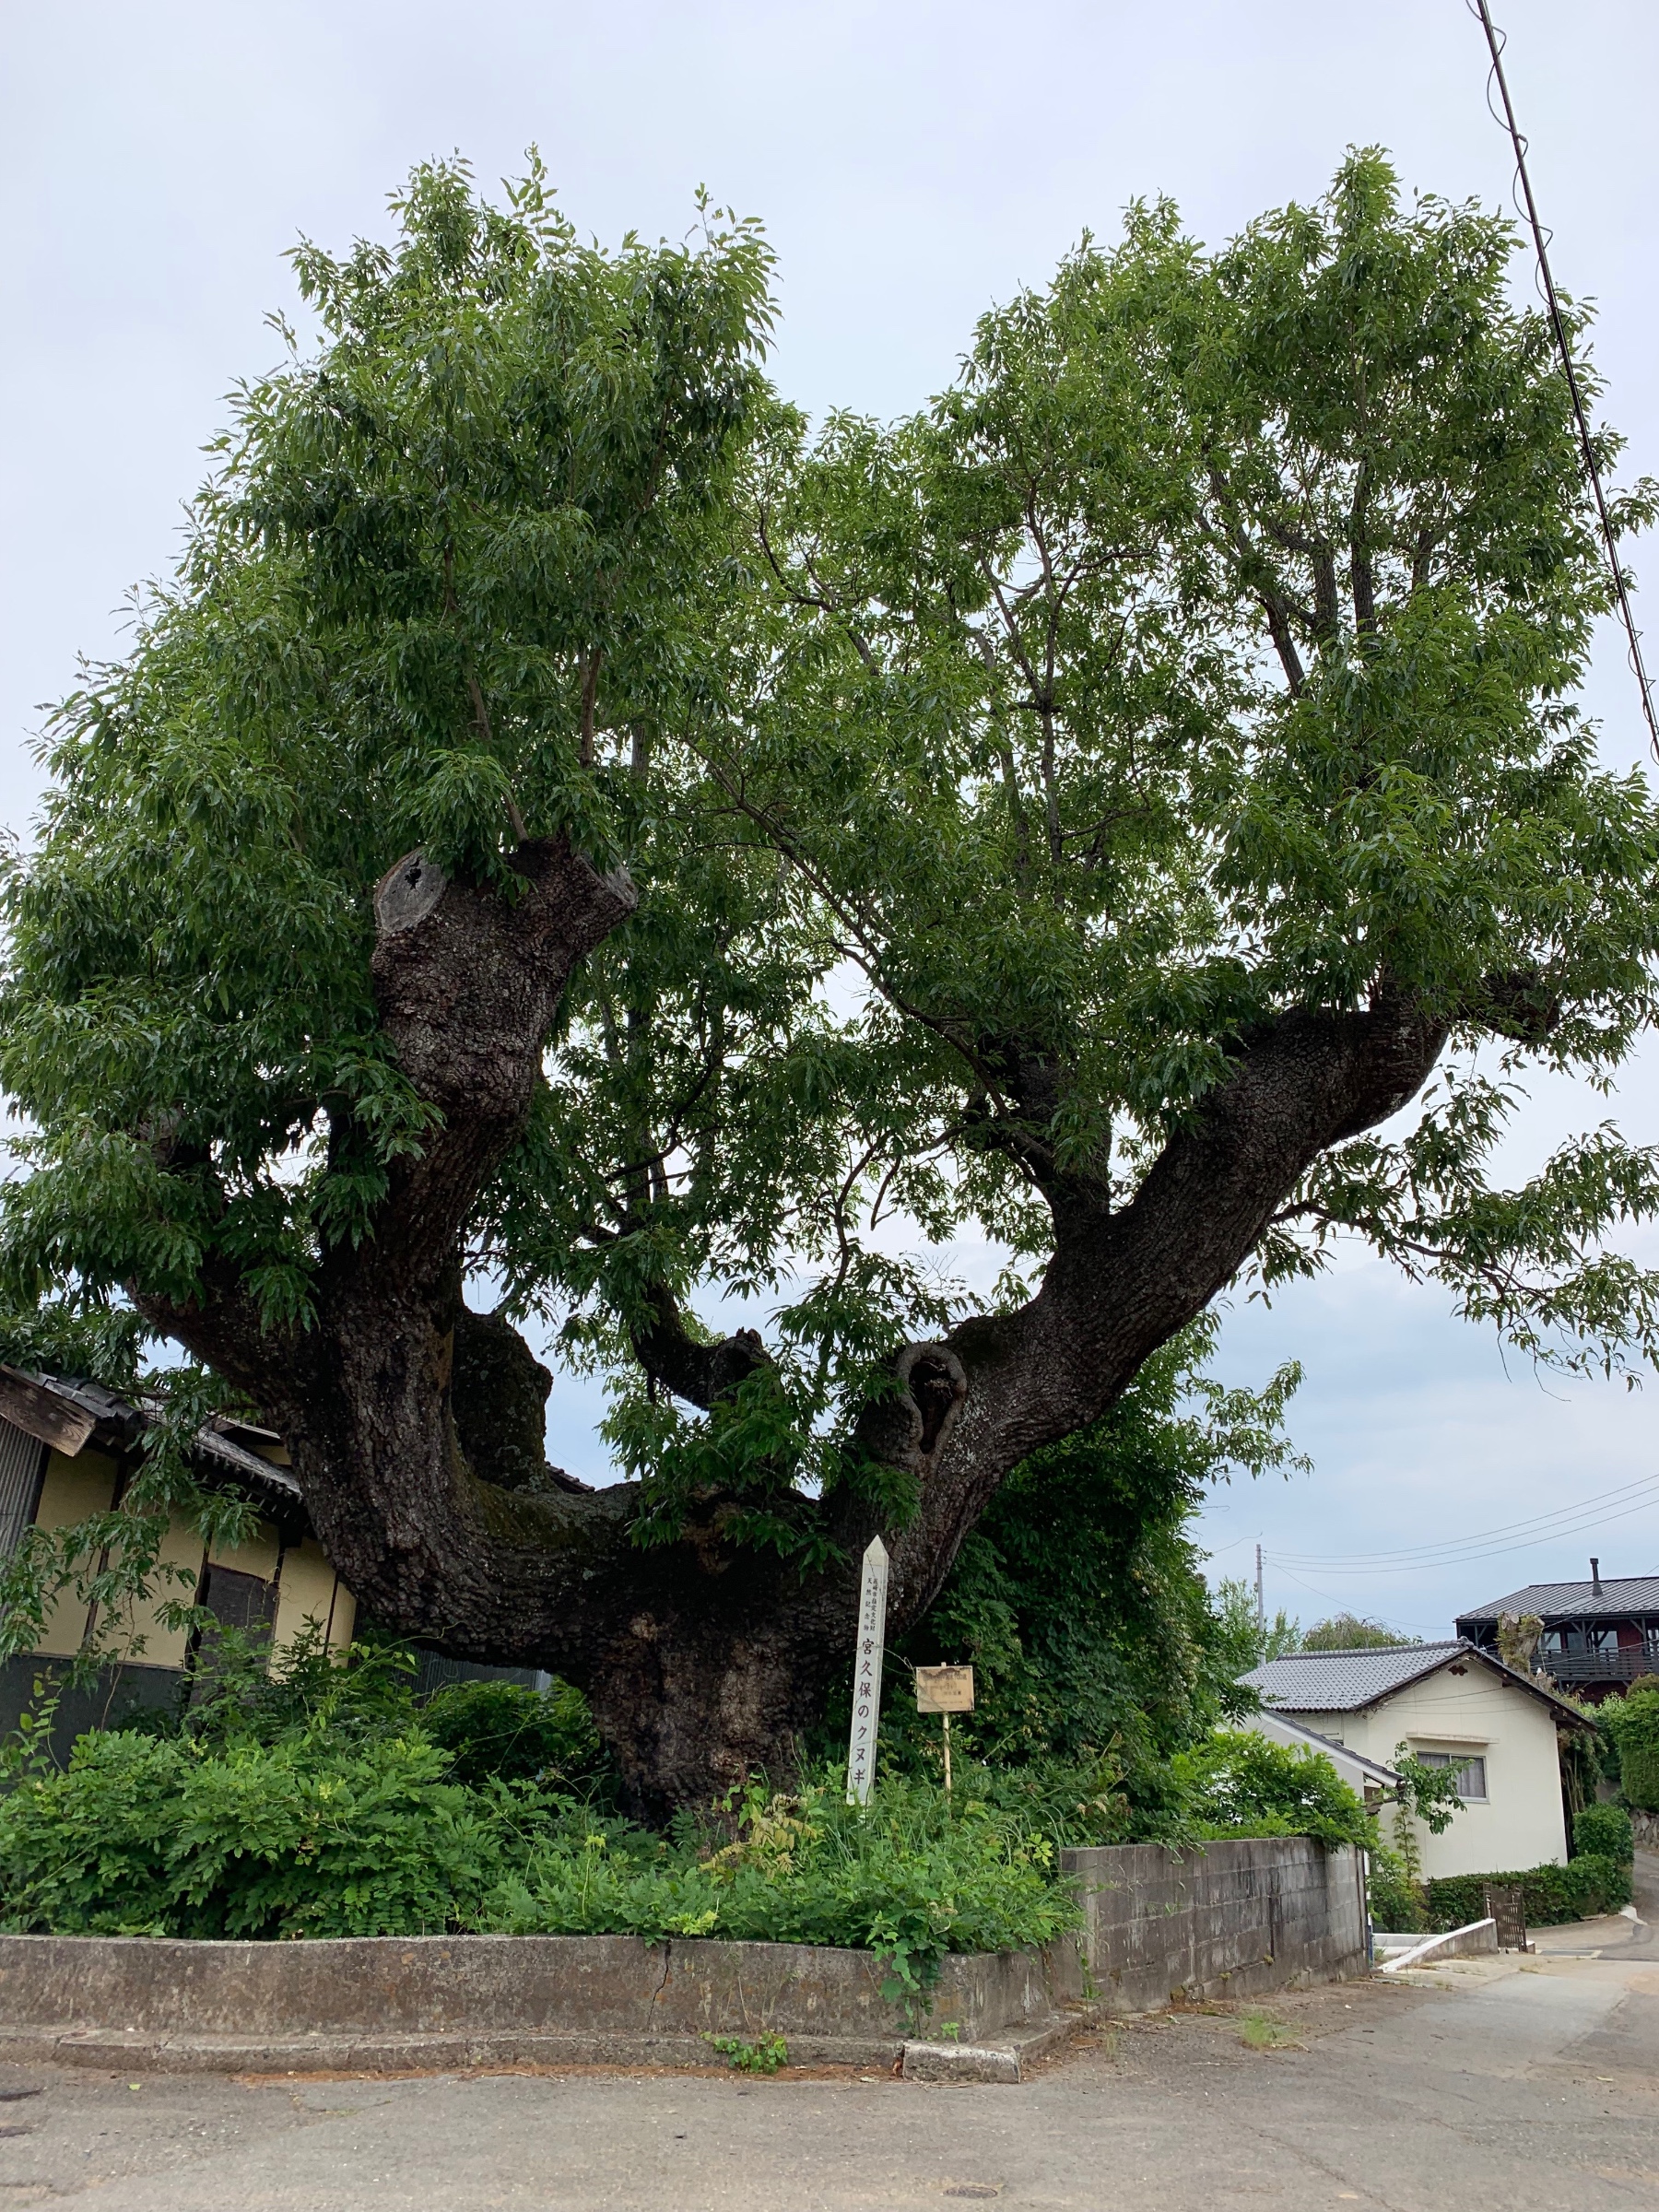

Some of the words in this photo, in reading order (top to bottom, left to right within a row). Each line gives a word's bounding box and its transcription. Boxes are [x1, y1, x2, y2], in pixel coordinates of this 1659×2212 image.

[864, 1577, 872, 1631] 天然記念物
[853, 1638, 874, 1785] 宮久保のクヌギ
